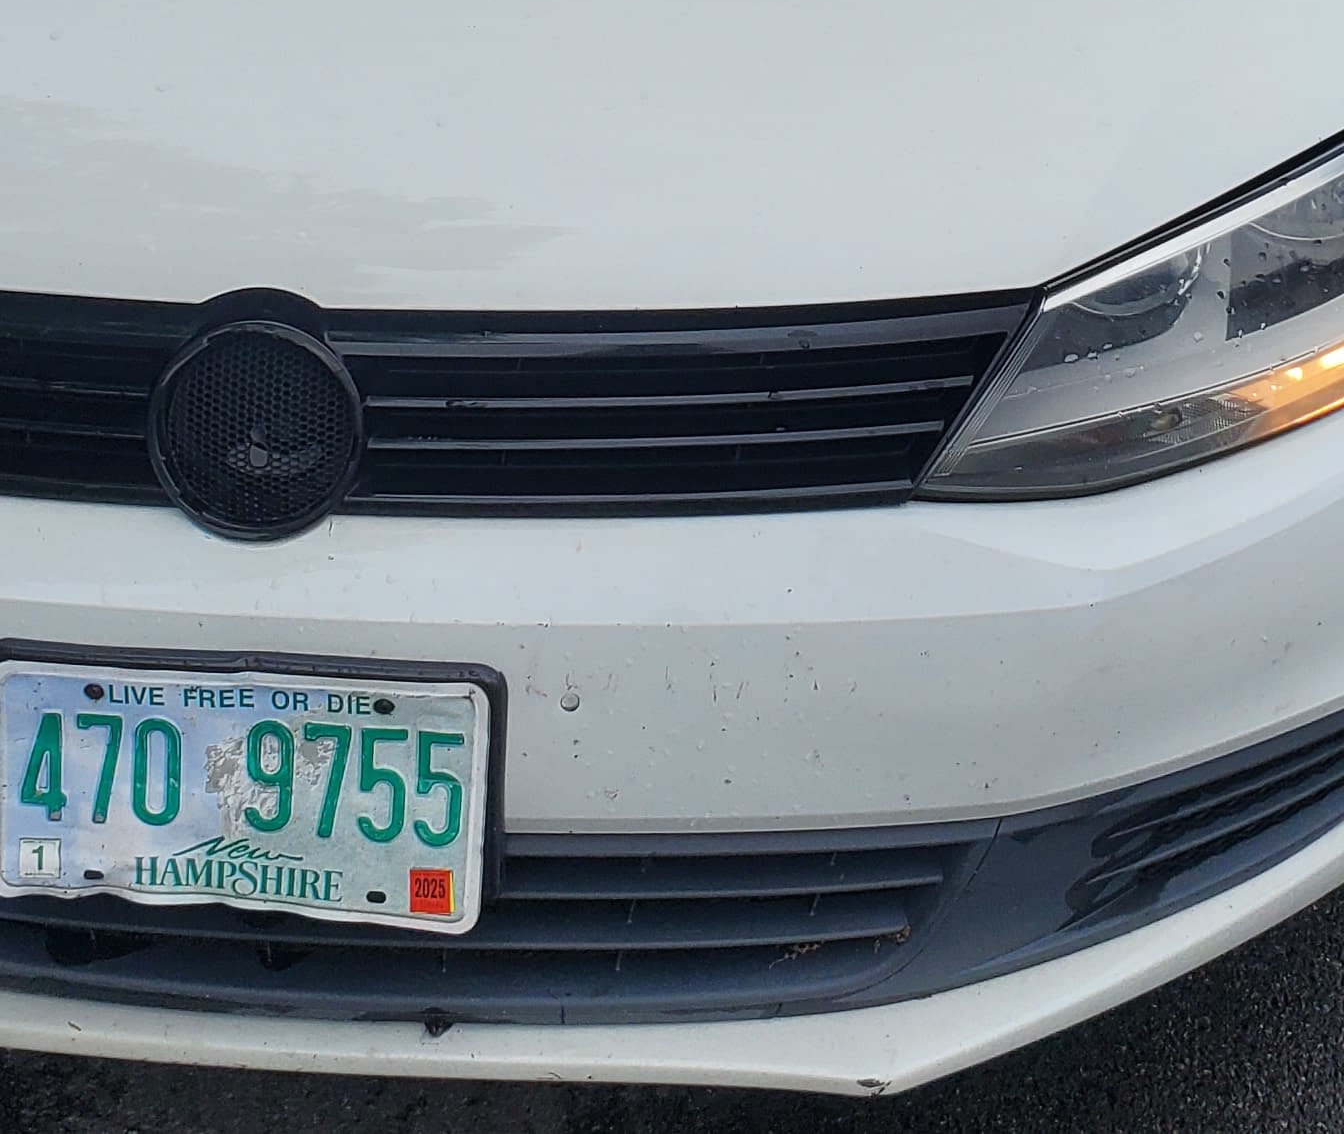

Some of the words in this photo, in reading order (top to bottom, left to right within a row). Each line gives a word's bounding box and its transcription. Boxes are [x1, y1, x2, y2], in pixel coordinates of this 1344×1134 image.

[108, 684, 165, 706] LIVE
[183, 688, 255, 708] FREE
[271, 691, 309, 712] OR
[327, 693, 372, 715] DIE
[21, 712, 182, 826] 470
[244, 719, 465, 847] 9755
[31, 845, 44, 870] 1
[172, 835, 303, 861] New
[134, 855, 343, 903] HAMPSHIRE
[414, 877, 446, 899] 2025
